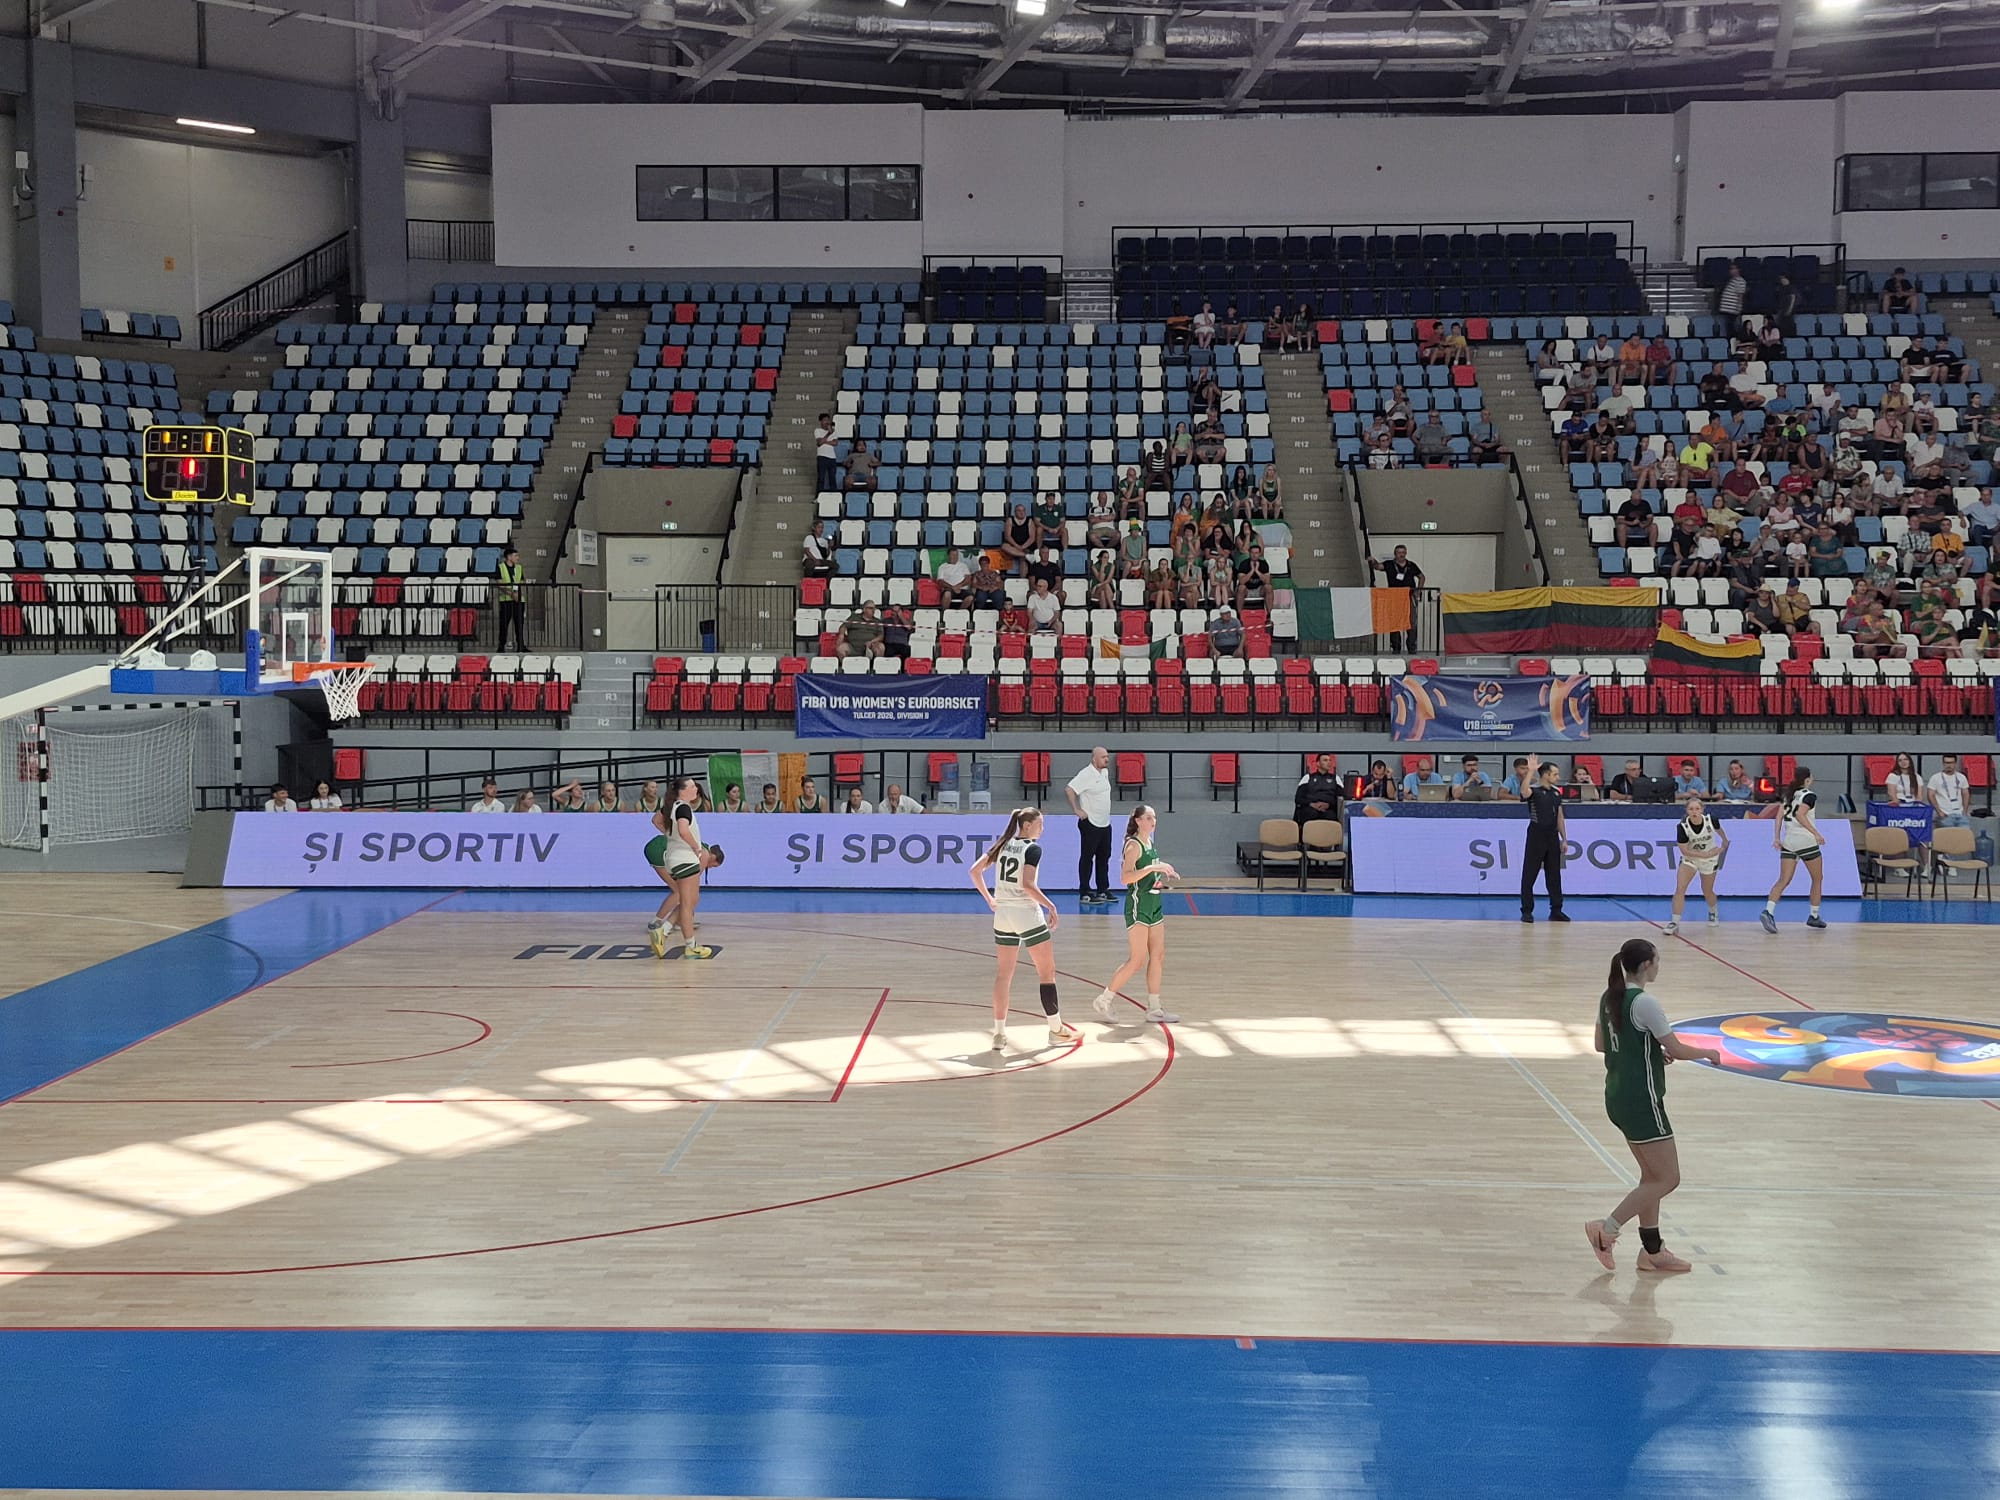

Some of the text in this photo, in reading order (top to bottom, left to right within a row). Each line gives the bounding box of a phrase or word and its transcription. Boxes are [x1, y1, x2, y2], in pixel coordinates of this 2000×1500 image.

[1501, 389, 1515, 397] R14
[1303, 493, 1318, 501] R10
[1534, 492, 1550, 500] R10
[545, 520, 557, 528] R9
[776, 522, 788, 530] R9
[1545, 518, 1557, 526] R9
[772, 551, 783, 559] R8
[1313, 549, 1325, 557] R8
[1553, 548, 1565, 556] R8
[1562, 579, 1575, 587] R7
[758, 611, 770, 619] R6
[615, 656, 627, 665] R4
[605, 693, 617, 701] R3
[801, 696, 980, 710] FIBA U18 WOMEN'S EUROBASKET
[897, 712, 923, 720] DIVISION
[1463, 719, 1480, 730] U18
[1887, 818, 1926, 828] molten
[359, 832, 560, 863] SPORTIV
[841, 833, 1008, 864] SPORT
[1541, 840, 1730, 870] PORT
[999, 855, 1019, 883] 12
[513, 944, 724, 960] FIBA
